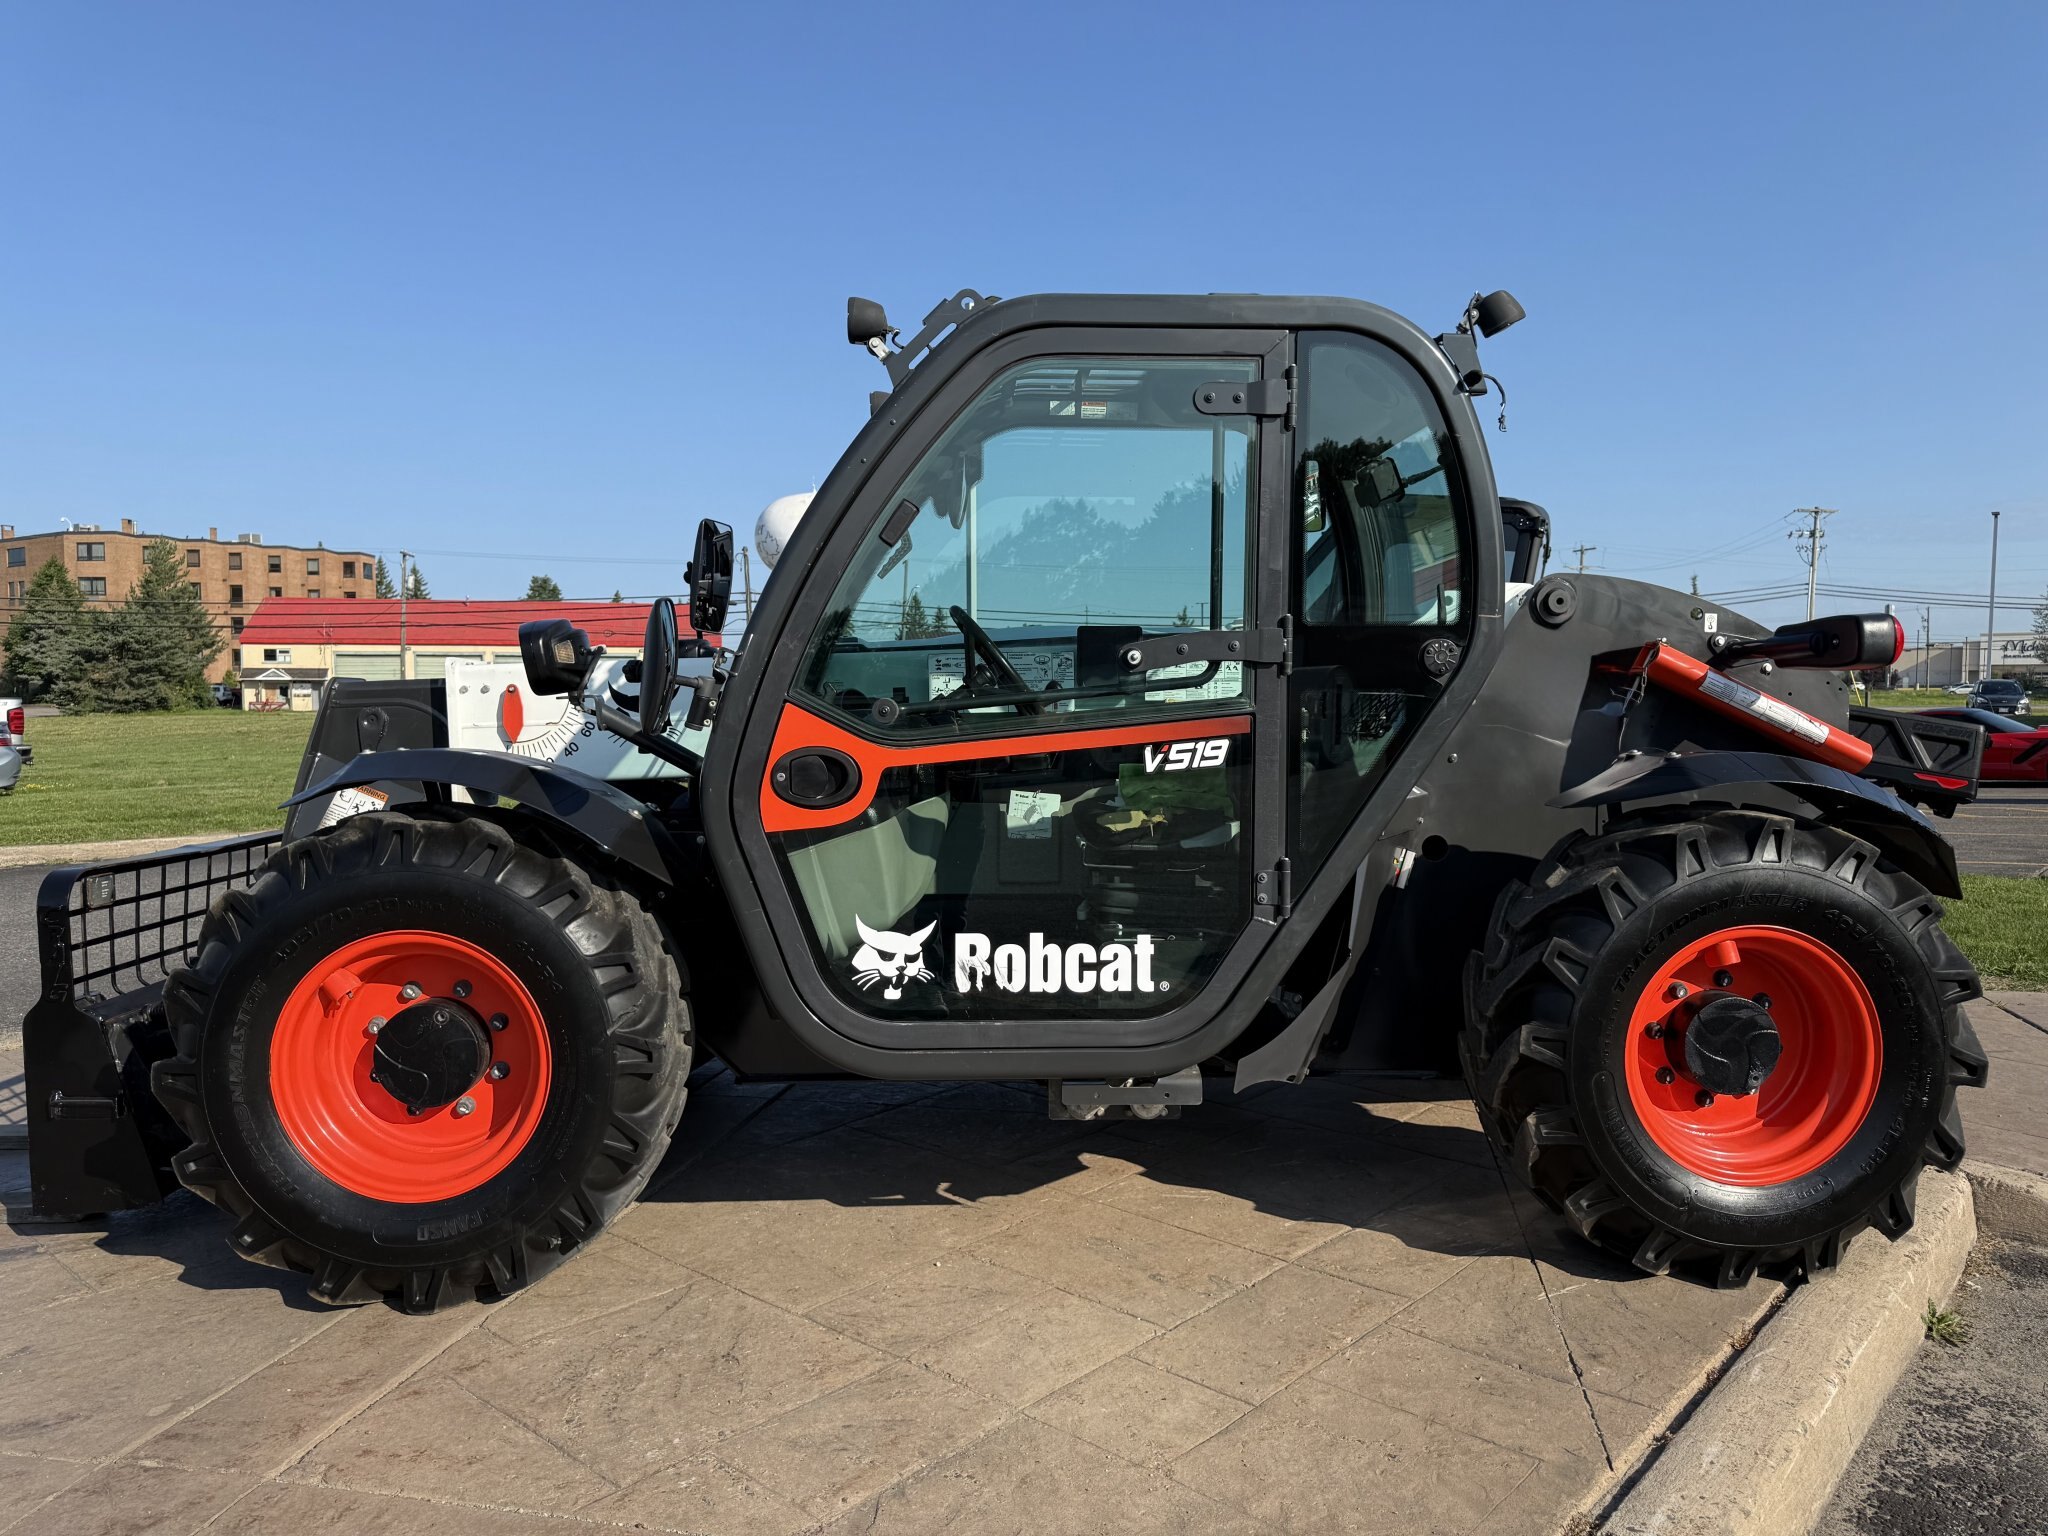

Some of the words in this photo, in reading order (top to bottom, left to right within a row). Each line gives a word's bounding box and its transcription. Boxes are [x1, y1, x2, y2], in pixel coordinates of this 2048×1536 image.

[564, 742, 579, 758] 40
[581, 721, 596, 738] 60
[1614, 892, 1811, 992] TRACTIONMASTER
[228, 973, 301, 1200] TRACTIONMASTER
